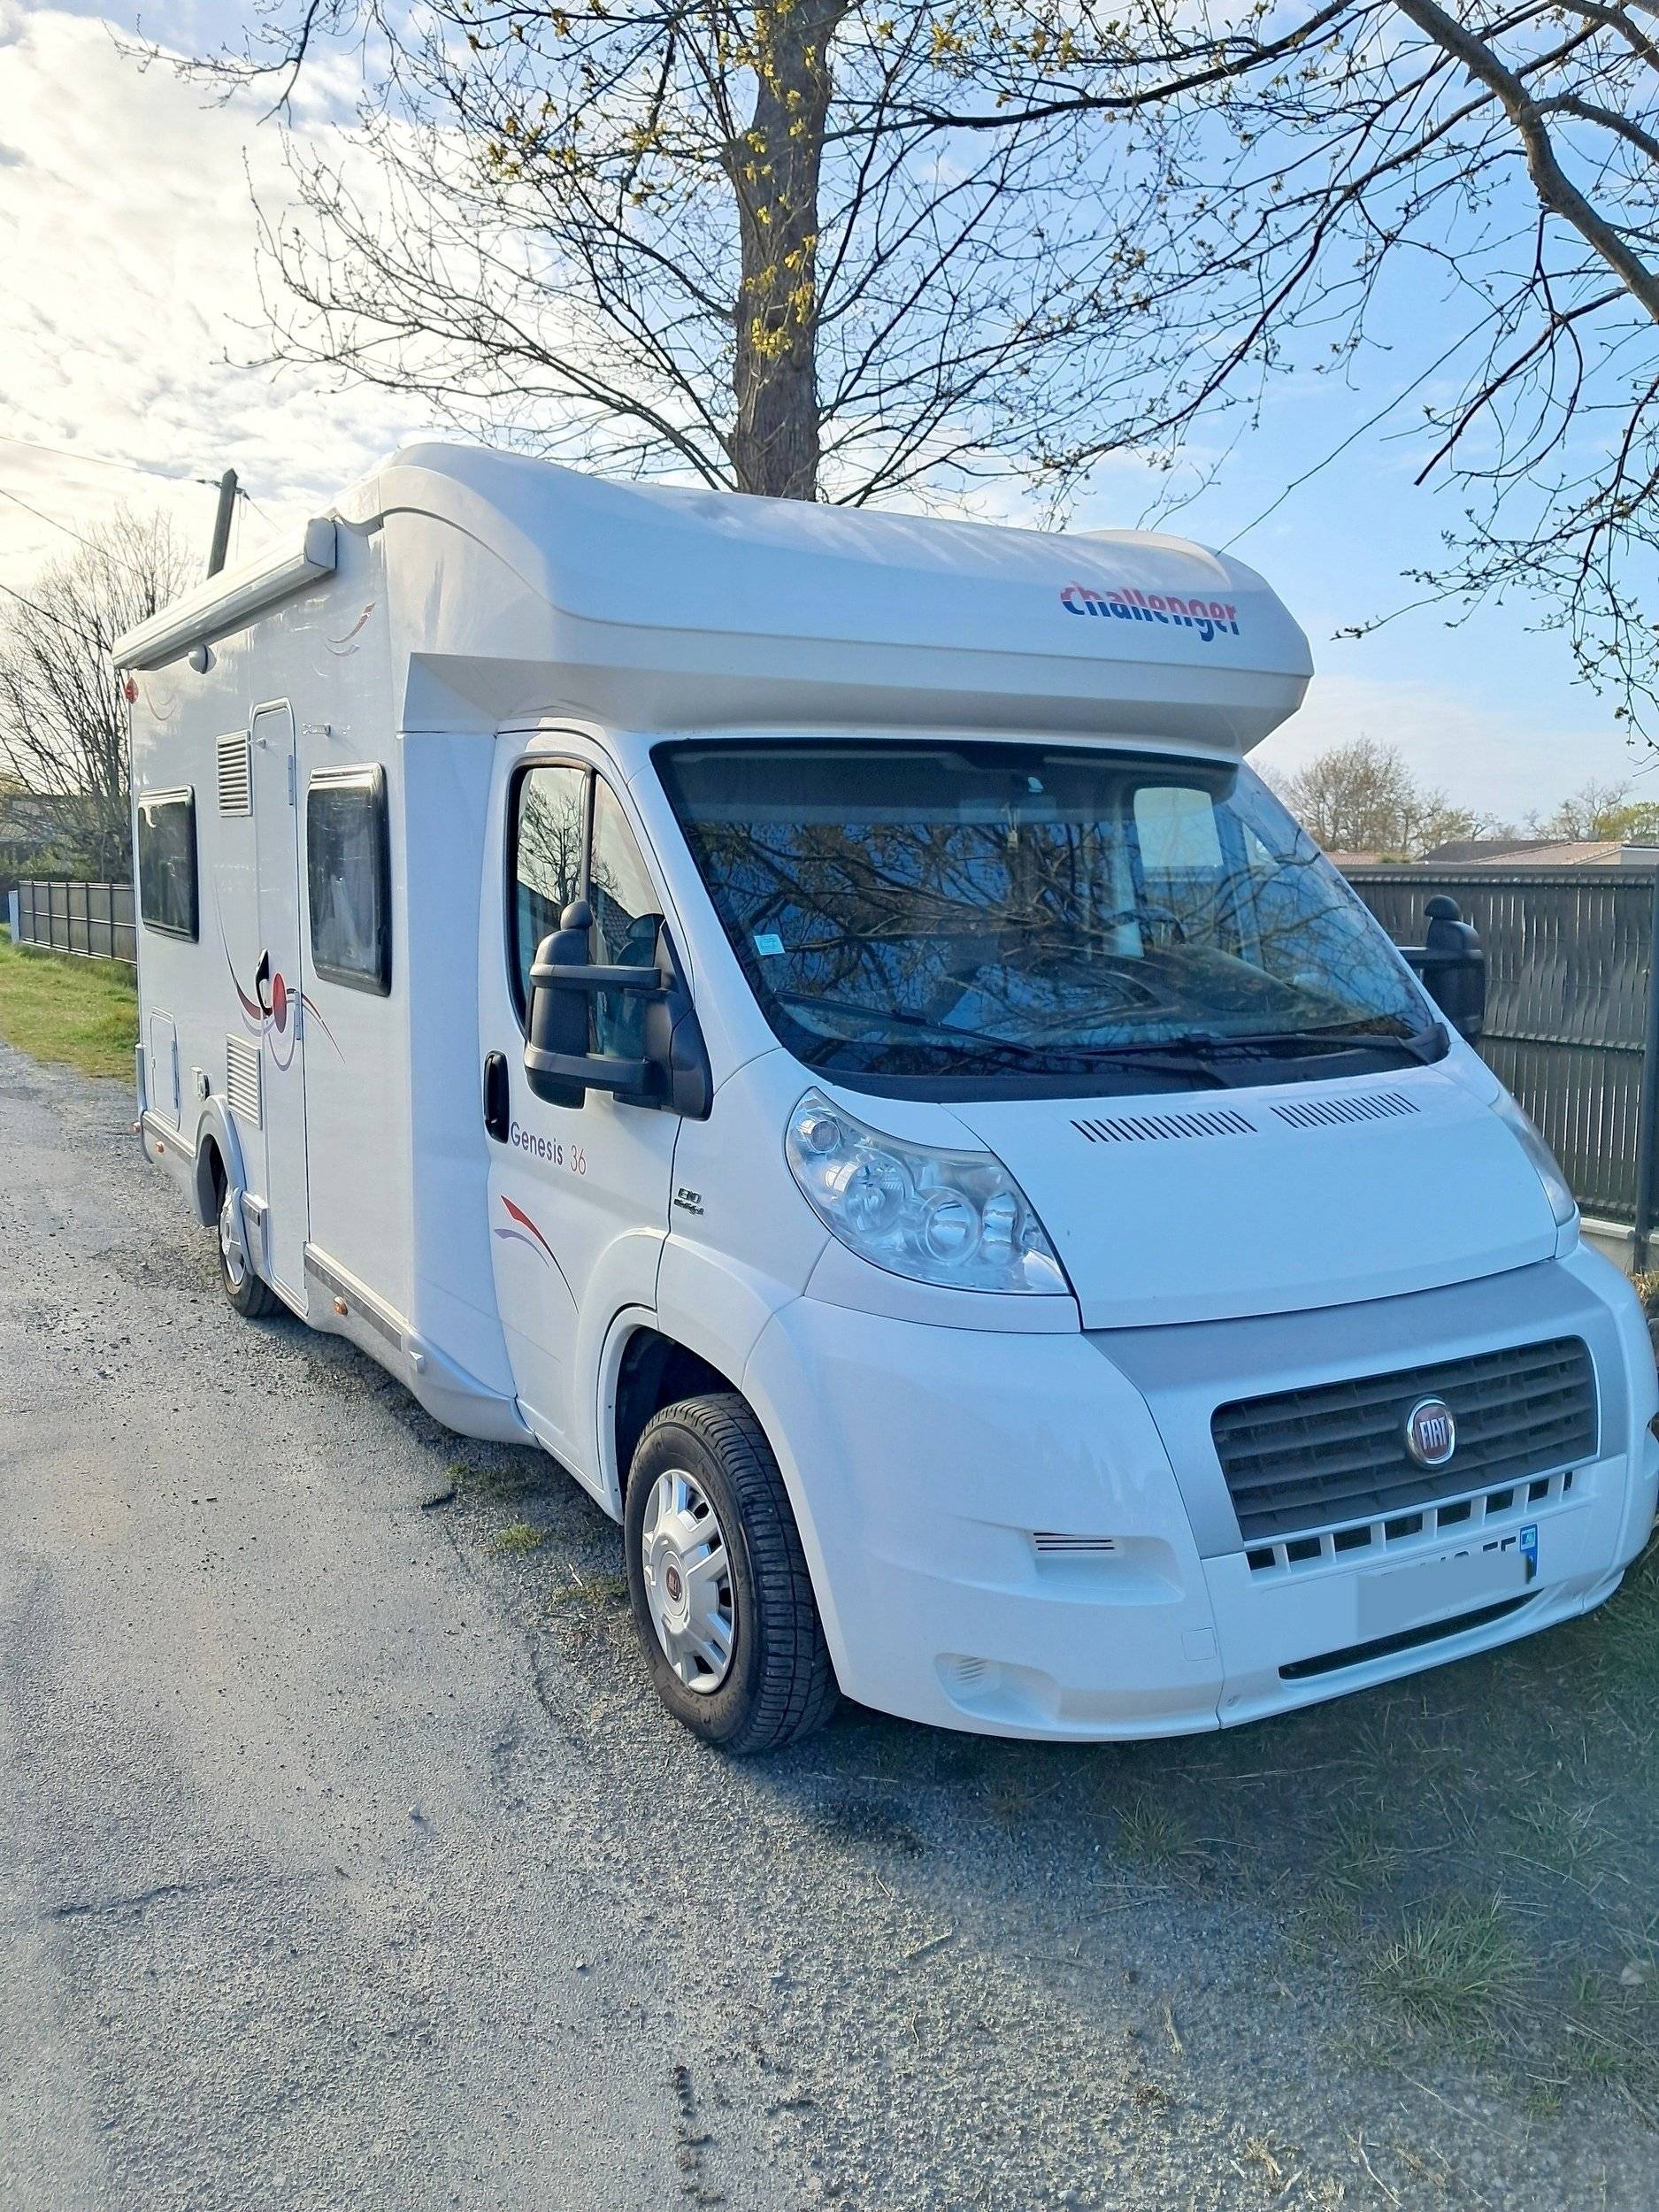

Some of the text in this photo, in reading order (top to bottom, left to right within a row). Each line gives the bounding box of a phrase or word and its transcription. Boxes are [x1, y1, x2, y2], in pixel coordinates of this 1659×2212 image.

[511, 1121, 587, 1175] Genesis 36
[1419, 1417, 1448, 1449] FIAT
